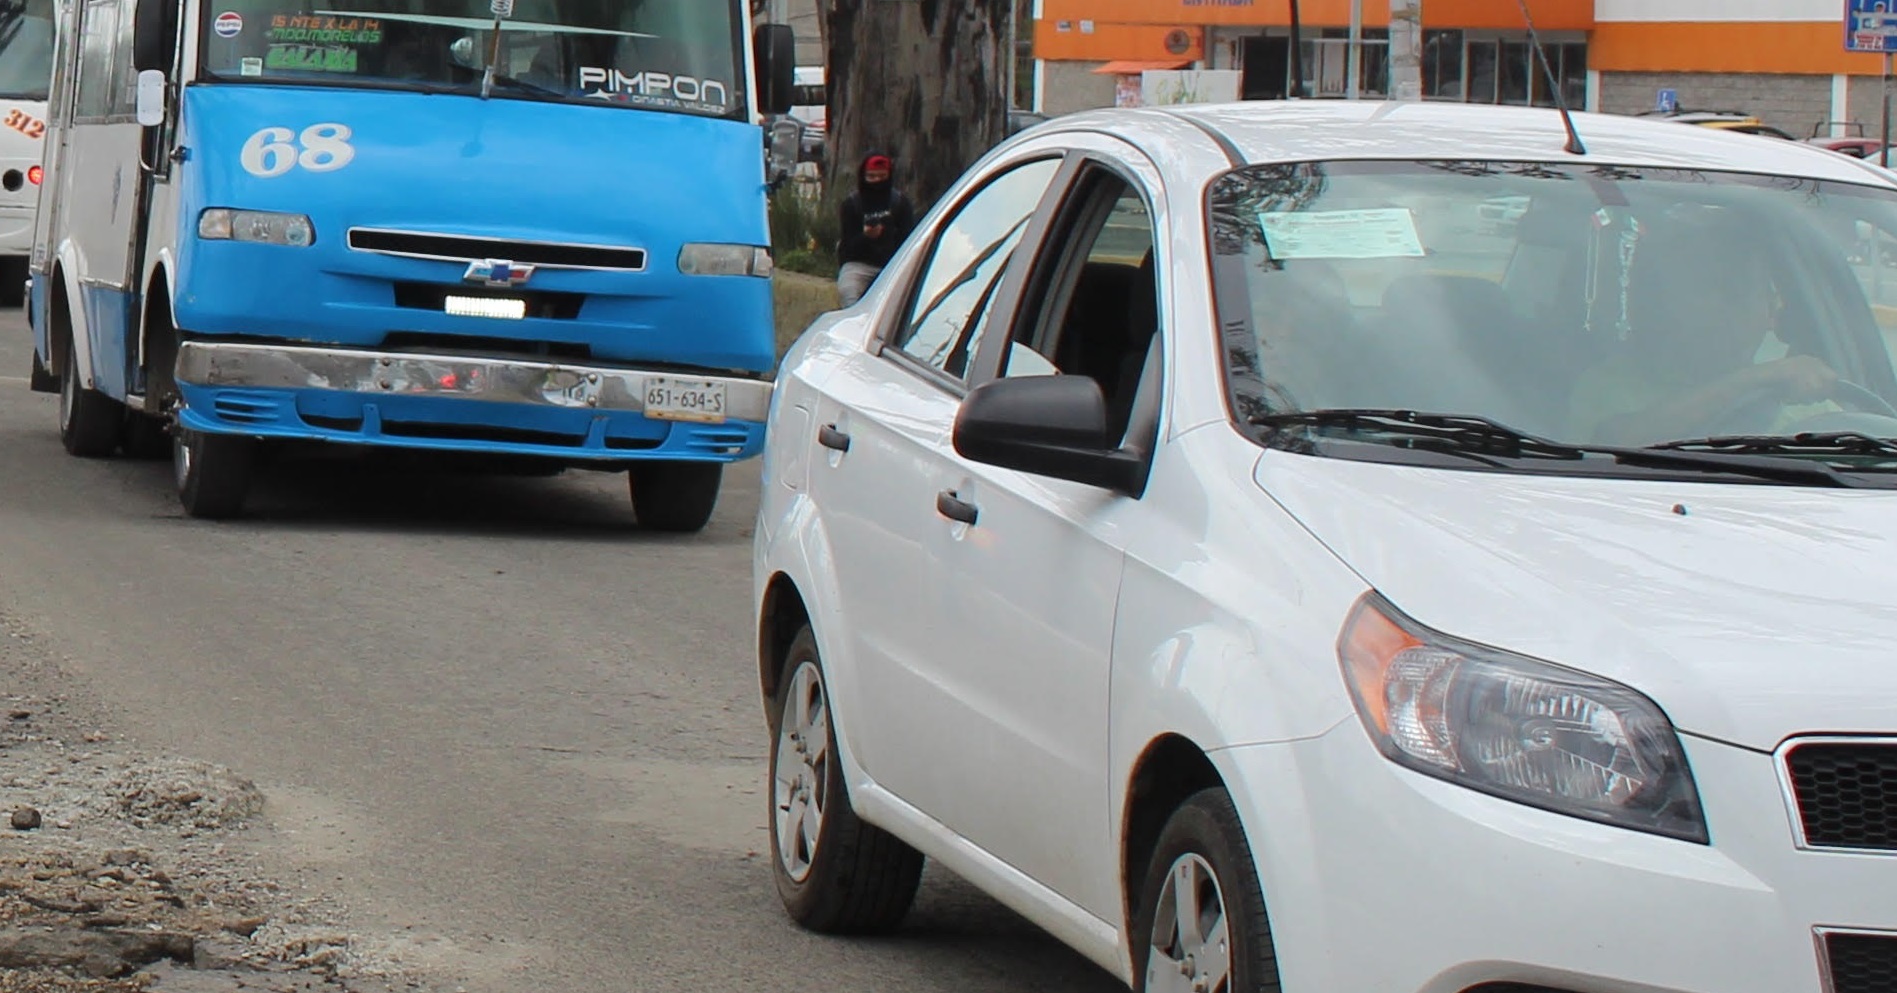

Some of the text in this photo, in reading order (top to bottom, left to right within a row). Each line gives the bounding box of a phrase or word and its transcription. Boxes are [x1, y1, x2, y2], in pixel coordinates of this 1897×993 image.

[290, 15, 319, 28] NTE
[324, 17, 336, 29] X
[338, 18, 358, 30] LA
[580, 66, 726, 105] PIMPON
[4, 109, 45, 138] 312
[240, 122, 355, 178] 68
[648, 389, 722, 412] 651-634-S
